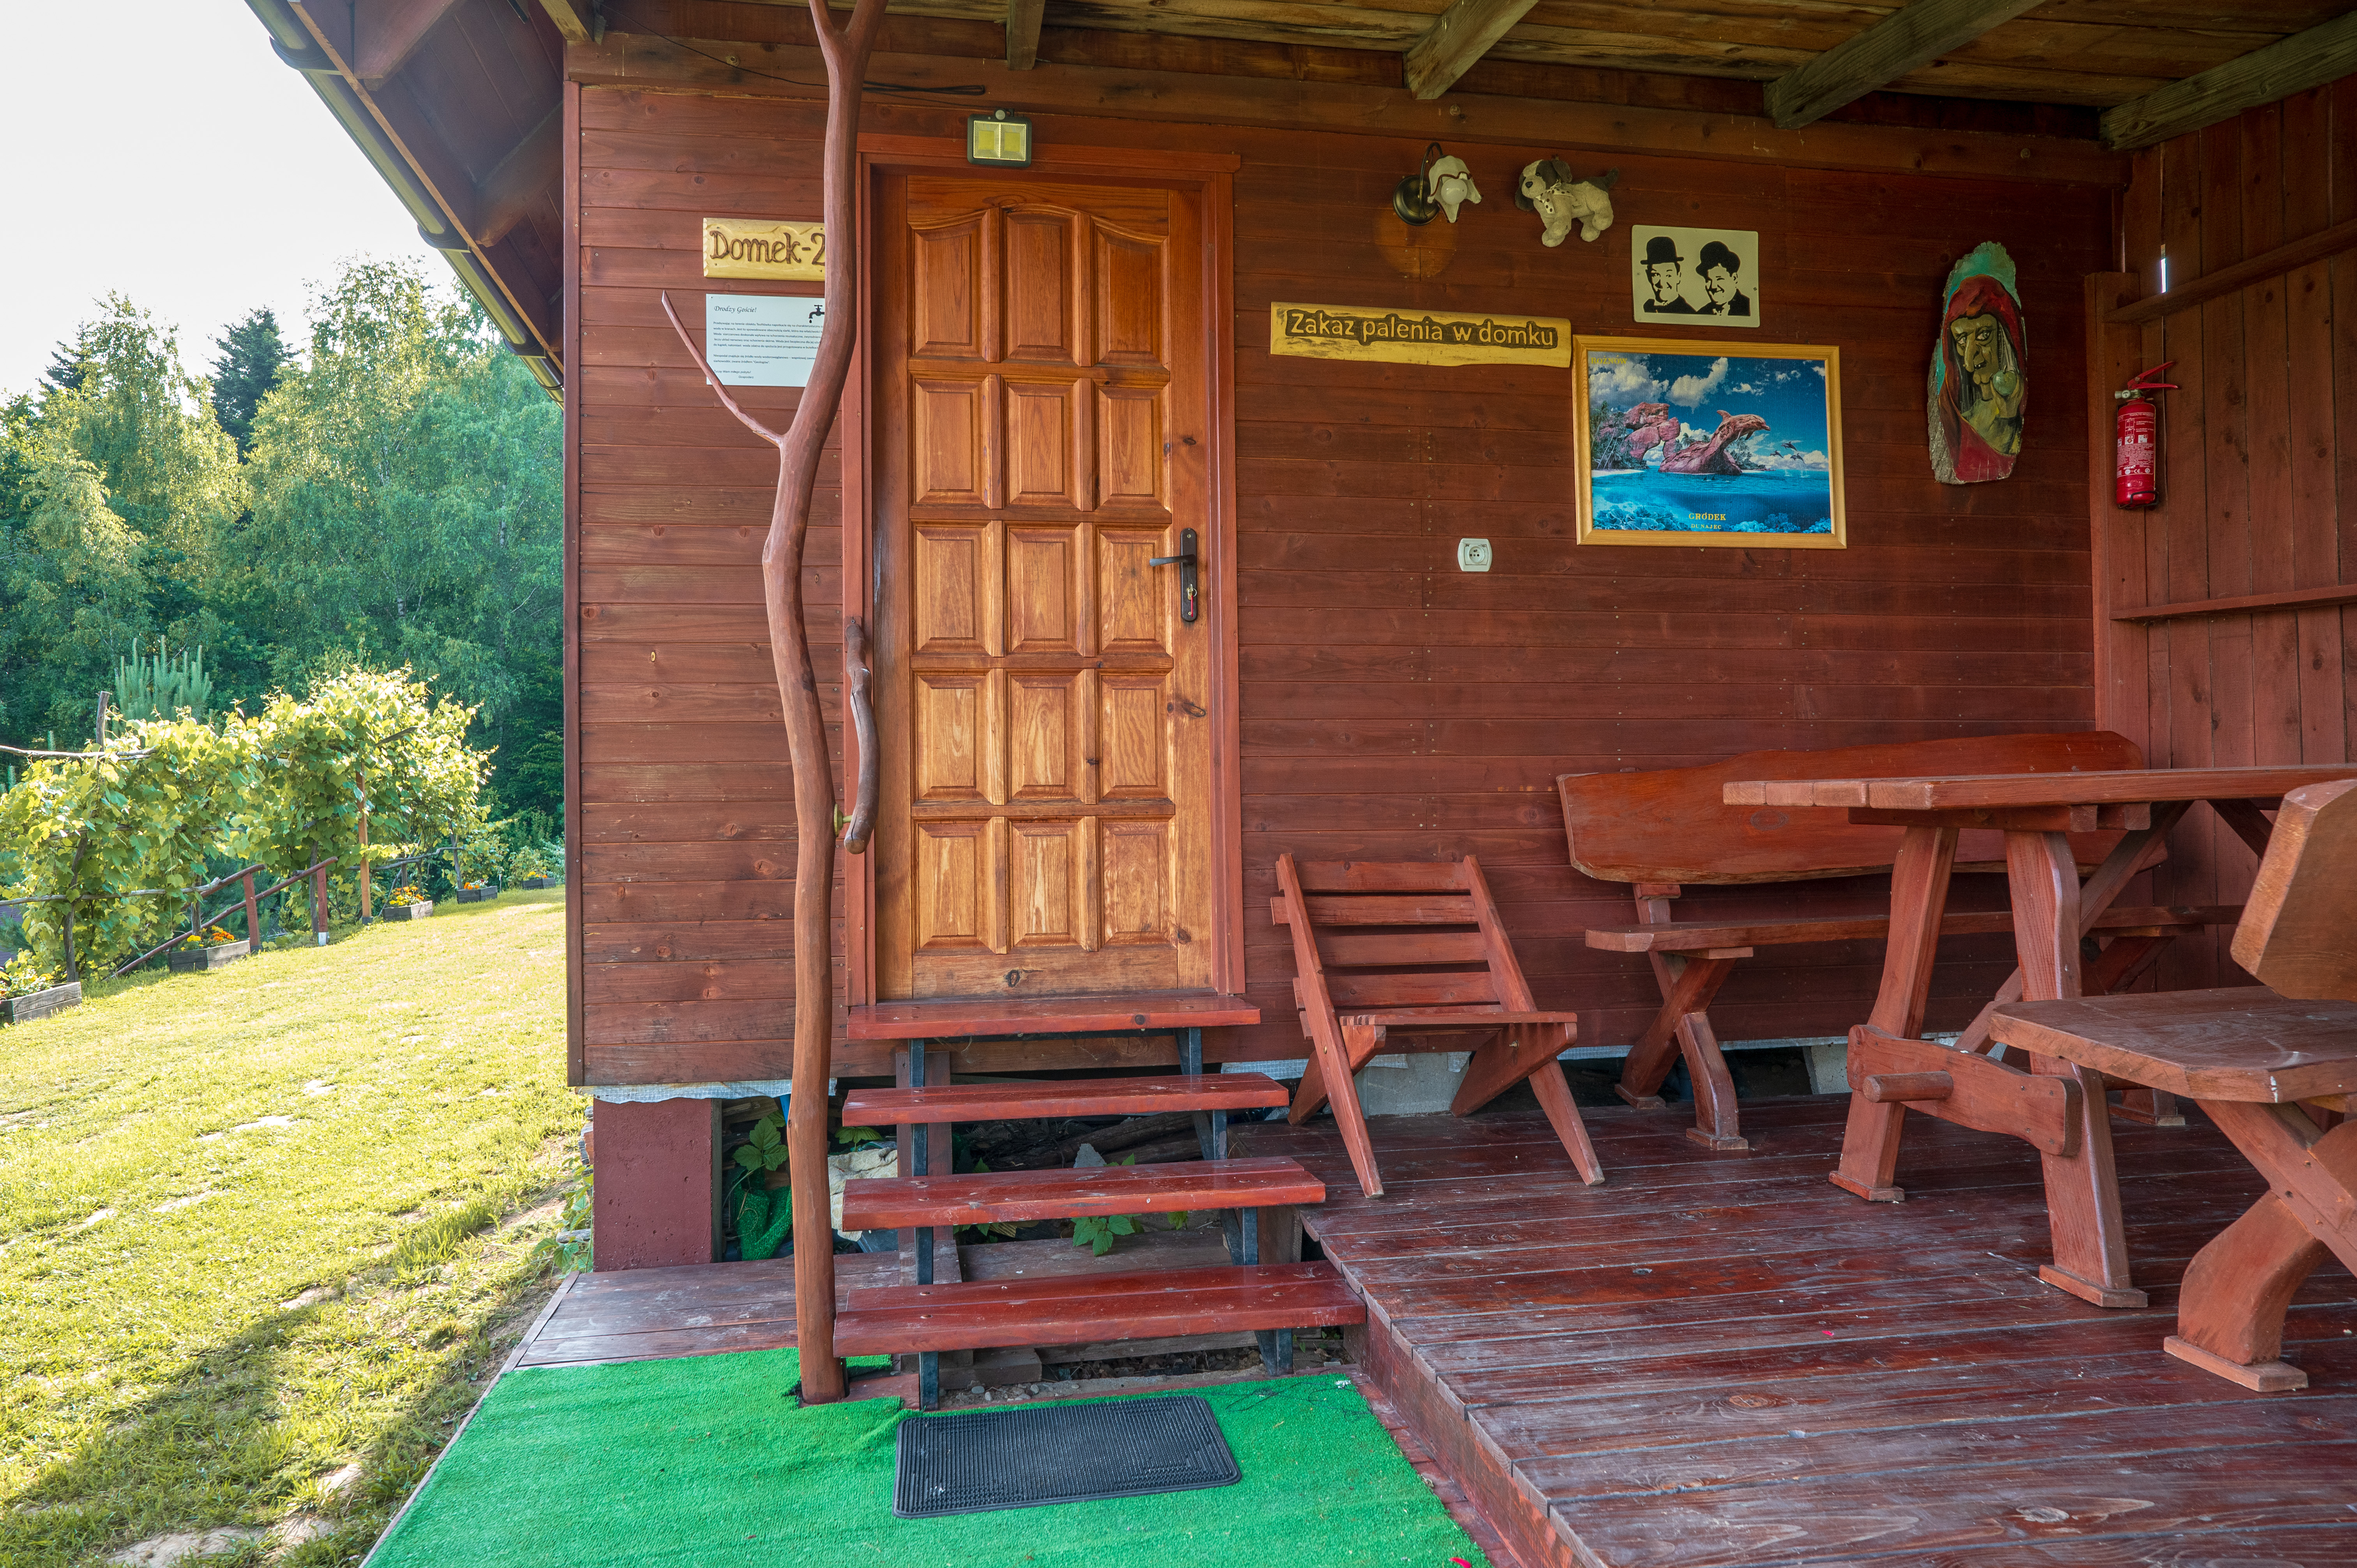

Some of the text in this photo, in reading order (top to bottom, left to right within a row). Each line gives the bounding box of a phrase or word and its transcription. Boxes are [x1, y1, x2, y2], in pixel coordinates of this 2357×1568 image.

[1291, 313, 1553, 345] Zakaz palenia w domku
[1591, 355, 1627, 364] ROŻNÓW
